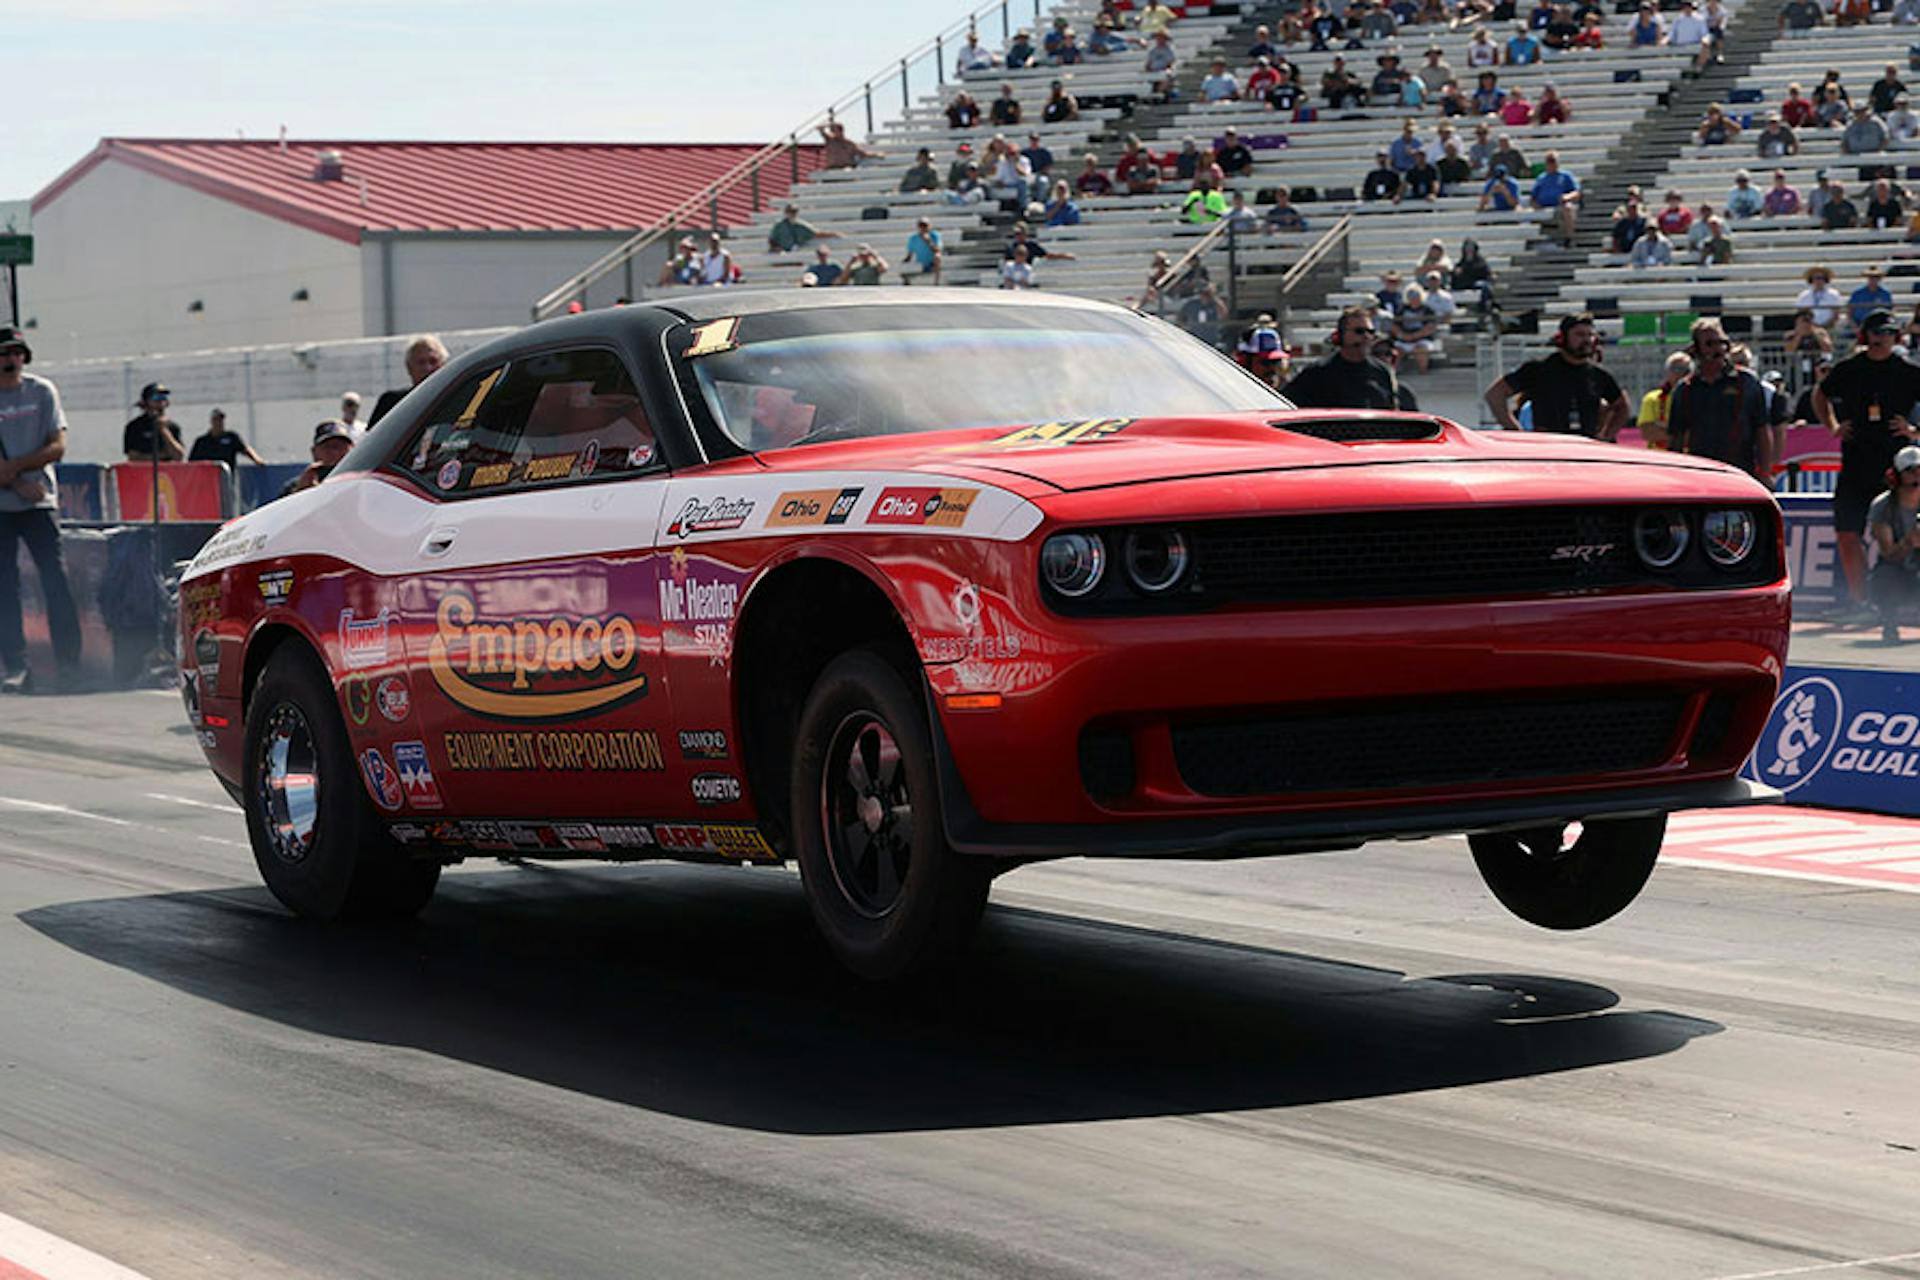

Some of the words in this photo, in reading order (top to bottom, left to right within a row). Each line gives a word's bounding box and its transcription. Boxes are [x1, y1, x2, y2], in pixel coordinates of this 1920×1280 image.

[684, 317, 741, 357] 1
[453, 369, 502, 429] 1
[780, 499, 820, 517] Ohio
[878, 497, 918, 516] Ohio
[1550, 543, 1615, 562] SRT
[660, 579, 687, 620] Mr.
[687, 577, 738, 620] Heater
[429, 585, 645, 718] Empaco
[1846, 711, 1920, 747] CO
[444, 733, 537, 769] EQUIPMENT
[536, 732, 664, 769] CORPORATION
[692, 778, 740, 798] COMETIC
